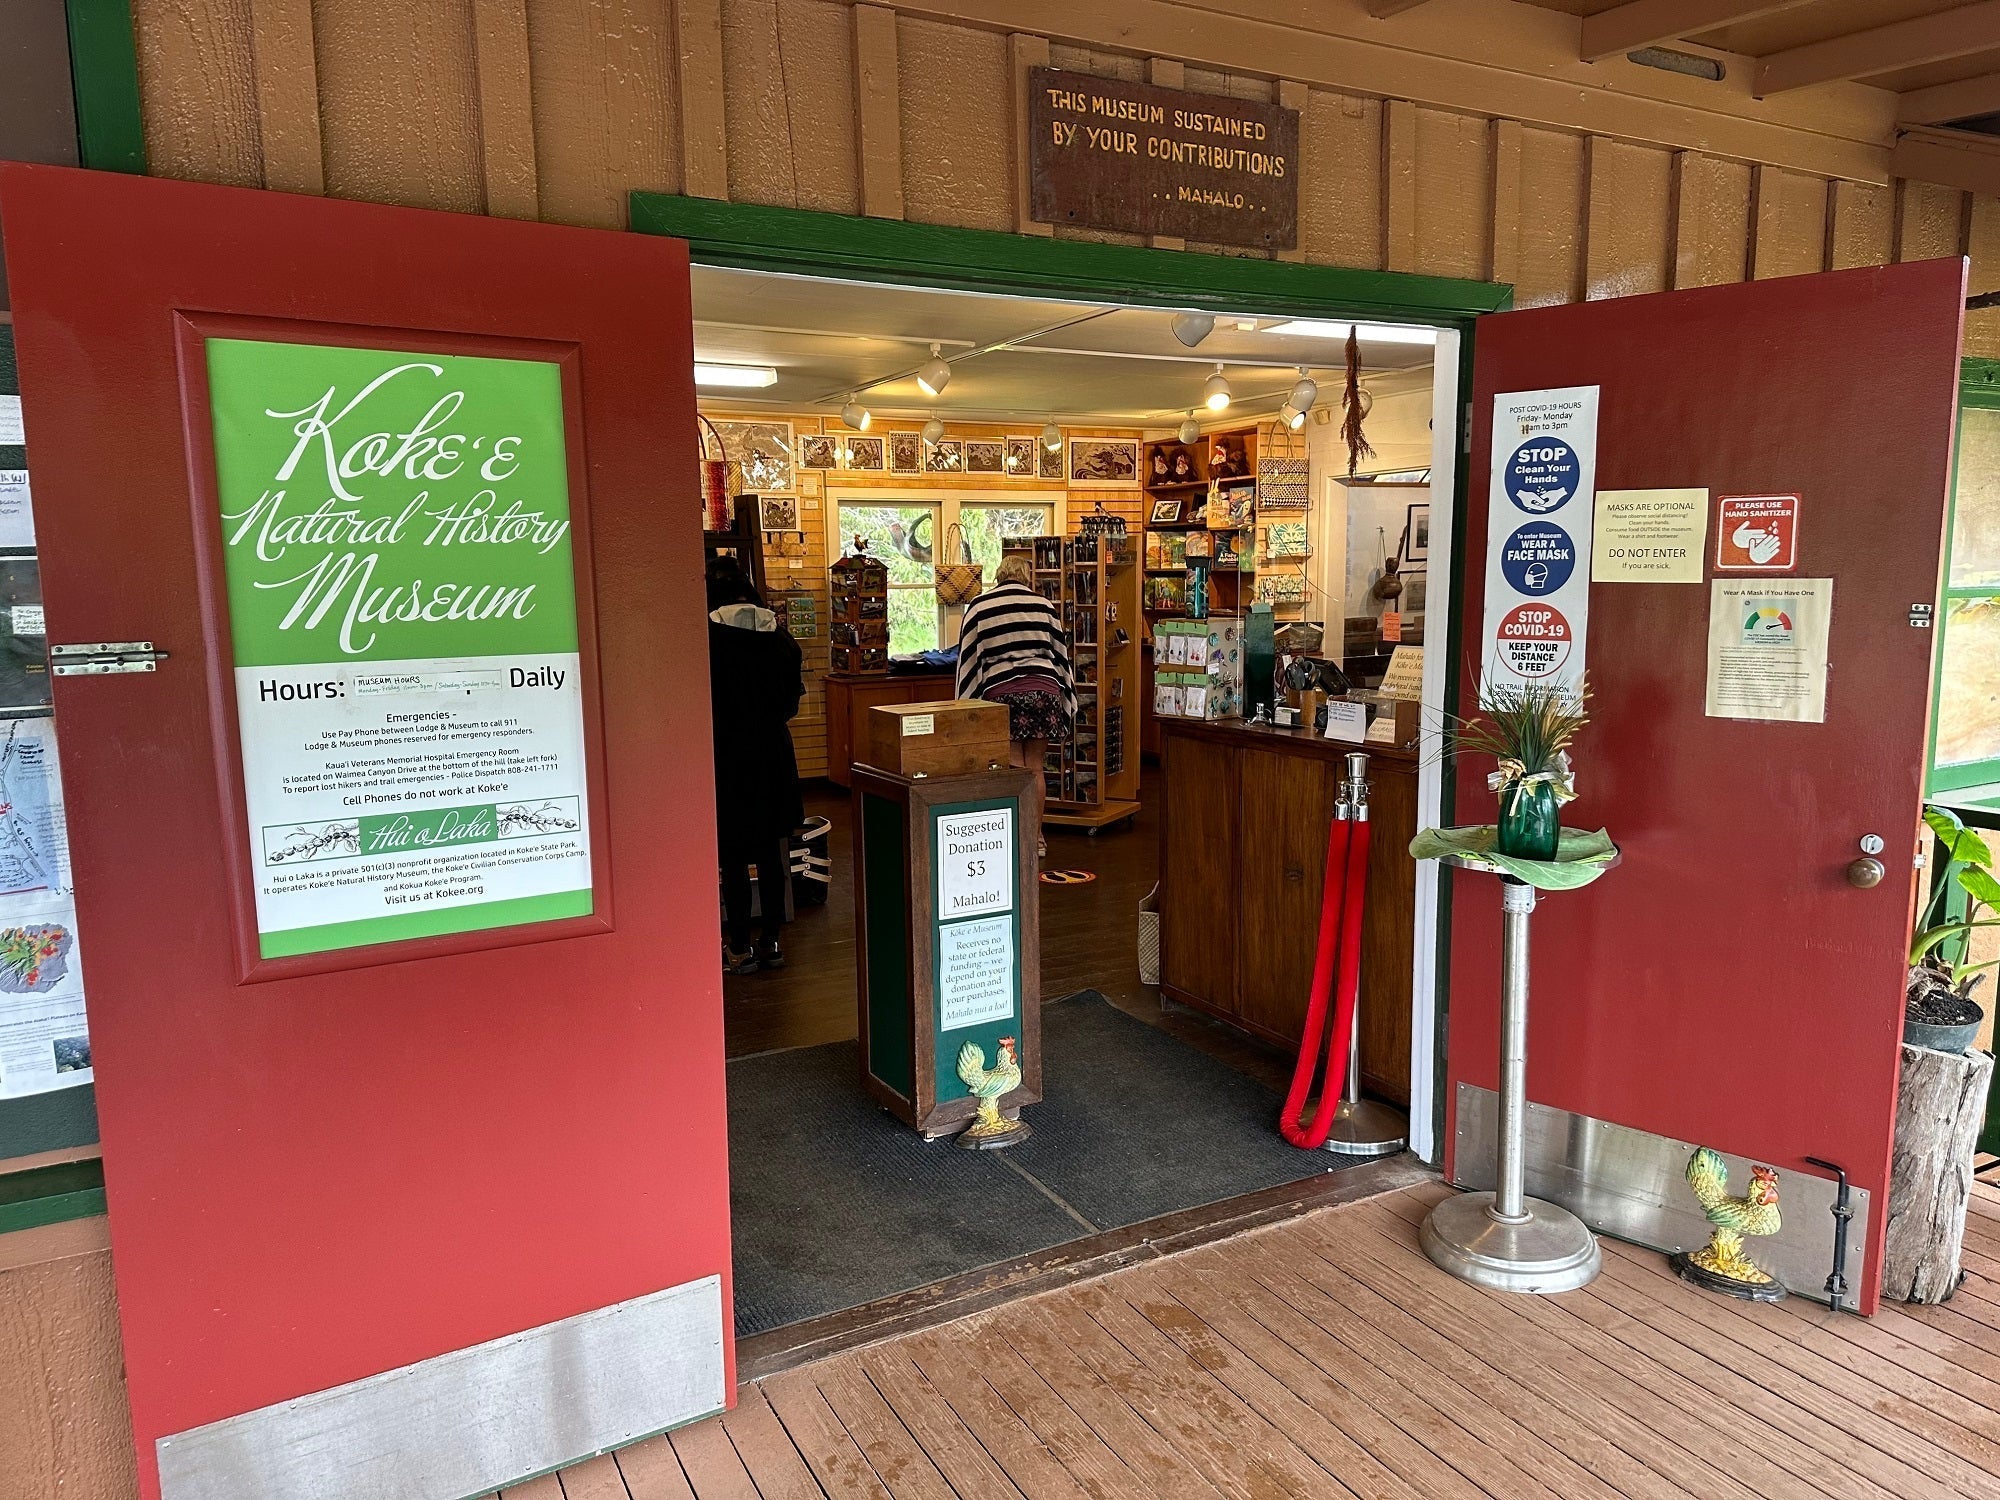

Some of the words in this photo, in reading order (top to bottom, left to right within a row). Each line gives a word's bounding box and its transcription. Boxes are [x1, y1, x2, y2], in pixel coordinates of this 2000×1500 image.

[1046, 89, 1086, 113] THIS
[1092, 95, 1164, 125] MUSEUM
[1174, 110, 1266, 141] SUSTAINED
[1053, 121, 1077, 146] BY
[1086, 126, 1138, 155] YOUR
[1147, 137, 1285, 178] CONTRIBUTIONS
[1509, 406, 1526, 414] POST
[1527, 404, 1557, 413] COVID-19
[1543, 412, 1573, 420] Monday
[1551, 422, 1568, 430] 3pm
[1518, 447, 1567, 463] STOP
[1515, 465, 1544, 474] Clean
[1547, 464, 1571, 472] Your
[1525, 475, 1558, 484] Hands
[1607, 503, 1634, 511] MASKS
[1636, 503, 1651, 511] ARE
[1653, 502, 1695, 511] OPTIONAL
[220, 489, 429, 562] Natural
[424, 489, 570, 554] History
[1521, 540, 1548, 548] WEAR
[1549, 539, 1556, 548] A
[1507, 550, 1536, 562] FACE
[1537, 548, 1569, 561] MASK
[1609, 549, 1624, 557] DO
[1628, 549, 1650, 557] NOT
[1653, 548, 1686, 557] ENTER
[253, 552, 536, 654] Museum
[1518, 611, 1552, 623] STOP
[1505, 624, 1564, 636] COVID-19
[1508, 642, 1532, 651] KEEP
[1533, 643, 1558, 652] YOUR
[1511, 652, 1555, 661] DISTANCE
[1517, 662, 1523, 671] 6
[1525, 662, 1546, 672] FEET
[259, 679, 345, 702] Hours:
[510, 666, 565, 690] Daily
[358, 677, 392, 687] MUSEUM
[395, 676, 420, 684] HOURS
[386, 711, 450, 723] Emergencies
[322, 731, 336, 739] Use
[338, 730, 353, 738] Pay
[354, 728, 379, 736] Phone
[381, 726, 414, 734] between
[415, 724, 439, 732] Lodge
[448, 721, 479, 730] Museum
[490, 719, 503, 727] call
[304, 742, 329, 750] Lodge
[339, 739, 372, 748] Museum
[374, 737, 402, 746] phones
[404, 734, 437, 743] reserved
[438, 733, 449, 741] for
[451, 730, 491, 740] emergency
[493, 727, 534, 737] responders.
[351, 758, 385, 768] Veterans
[387, 755, 422, 764] Memorial
[424, 752, 455, 762] Hospital
[457, 749, 497, 759] Emergency
[498, 748, 519, 756] Room
[291, 774, 321, 782] located
[334, 771, 366, 779] Waimea
[368, 768, 396, 777] Canyon
[397, 766, 417, 774] Drive
[442, 762, 470, 770] bottom
[471, 760, 479, 768] of
[481, 759, 493, 767] the
[494, 757, 506, 765] hill
[507, 757, 525, 766] (take
[527, 755, 539, 763] left
[540, 753, 558, 762] fork)
[294, 785, 320, 793] report
[338, 781, 362, 789] hikers
[363, 779, 378, 787] and
[397, 773, 444, 784] emergencies
[451, 771, 473, 780] Police
[475, 769, 506, 778] Dispatch
[507, 764, 558, 774] 808-241-1711
[343, 796, 362, 806] Cell
[364, 793, 401, 803] Phones
[404, 791, 417, 800] do
[419, 789, 436, 798] not
[439, 787, 463, 797] work
[466, 786, 475, 794] at
[478, 782, 508, 793] Koke'e
[369, 815, 415, 850] Hui
[423, 809, 491, 846] Laka
[945, 818, 1005, 837] Suggested
[948, 839, 1003, 855] Donation
[967, 860, 985, 877] $3
[385, 895, 407, 905] Visit
[423, 892, 433, 900] at
[436, 885, 484, 898] Kokee.org
[953, 890, 1000, 908] Mahalo!
[956, 938, 990, 950] Receives
[991, 936, 1001, 944] no
[948, 953, 967, 961] state
[978, 945, 1005, 957] federal
[945, 971, 975, 983] depend
[988, 966, 1007, 975] your
[950, 961, 982, 972] funding
[951, 980, 986, 993] donation
[987, 976, 1002, 986] and
[946, 995, 965, 1007] your
